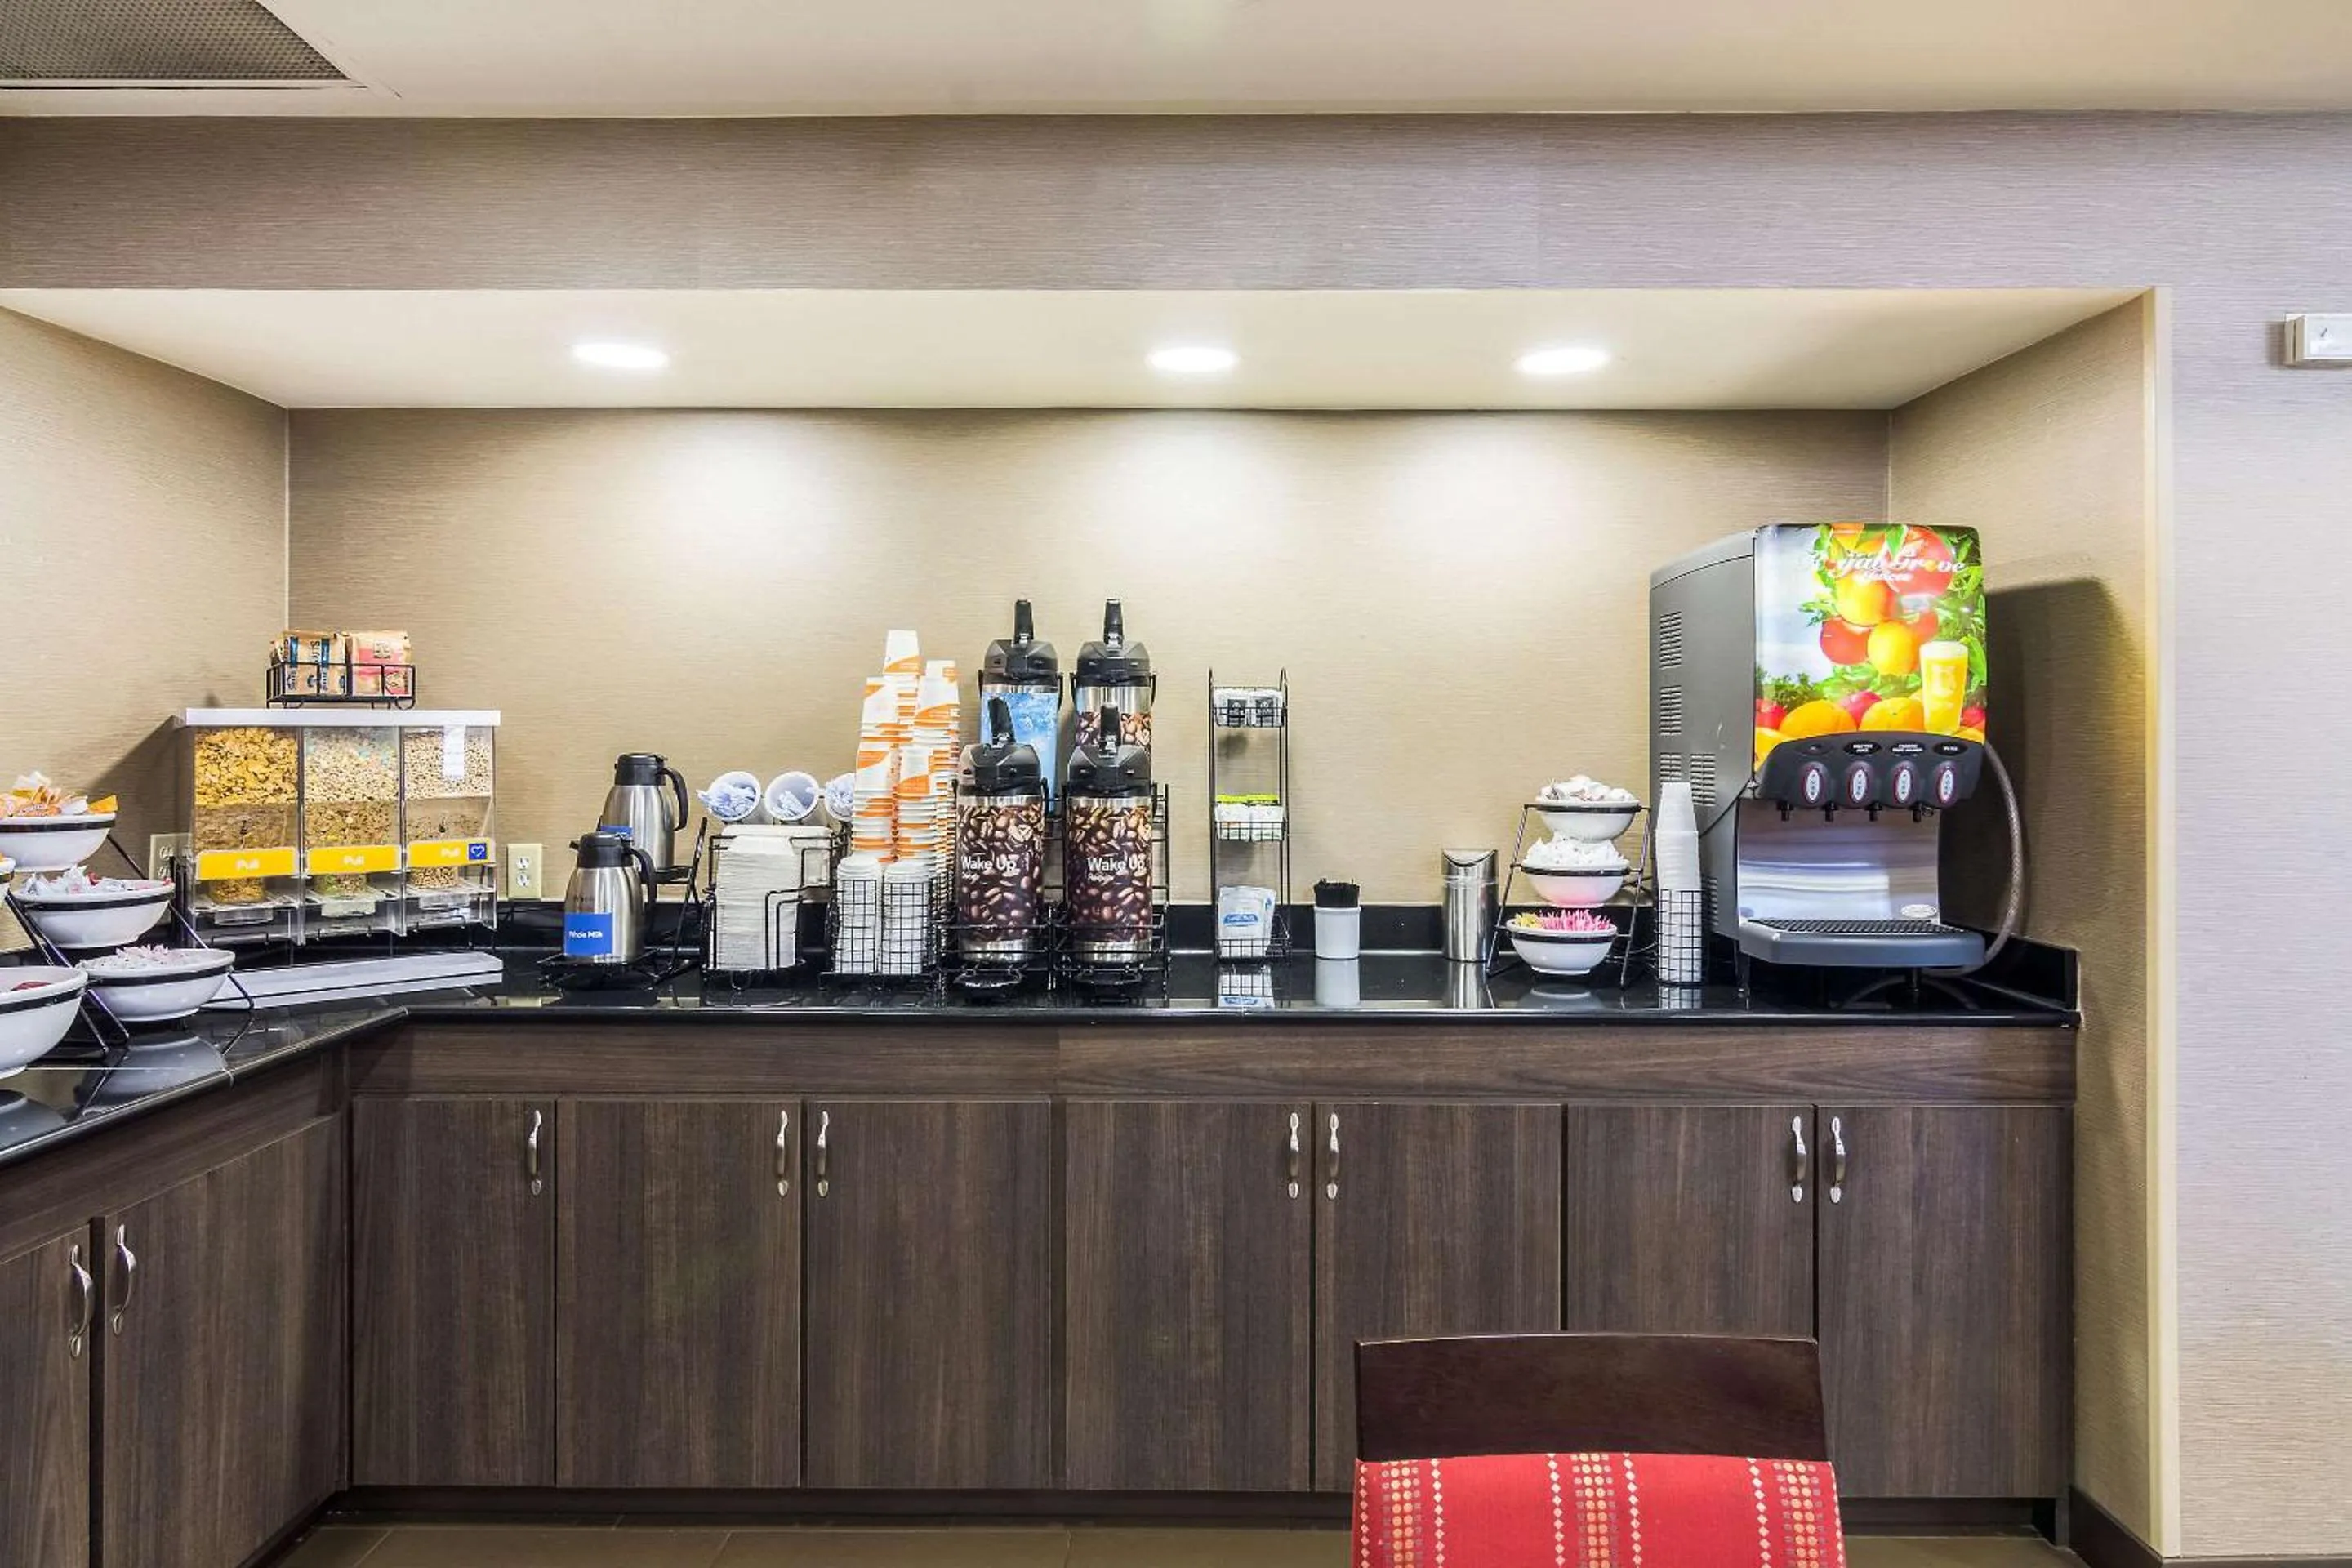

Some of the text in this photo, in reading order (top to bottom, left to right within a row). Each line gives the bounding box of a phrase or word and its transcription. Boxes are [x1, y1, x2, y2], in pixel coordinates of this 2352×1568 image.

[961, 855, 1018, 874] Wake Up
[1087, 857, 1126, 871] Wake
